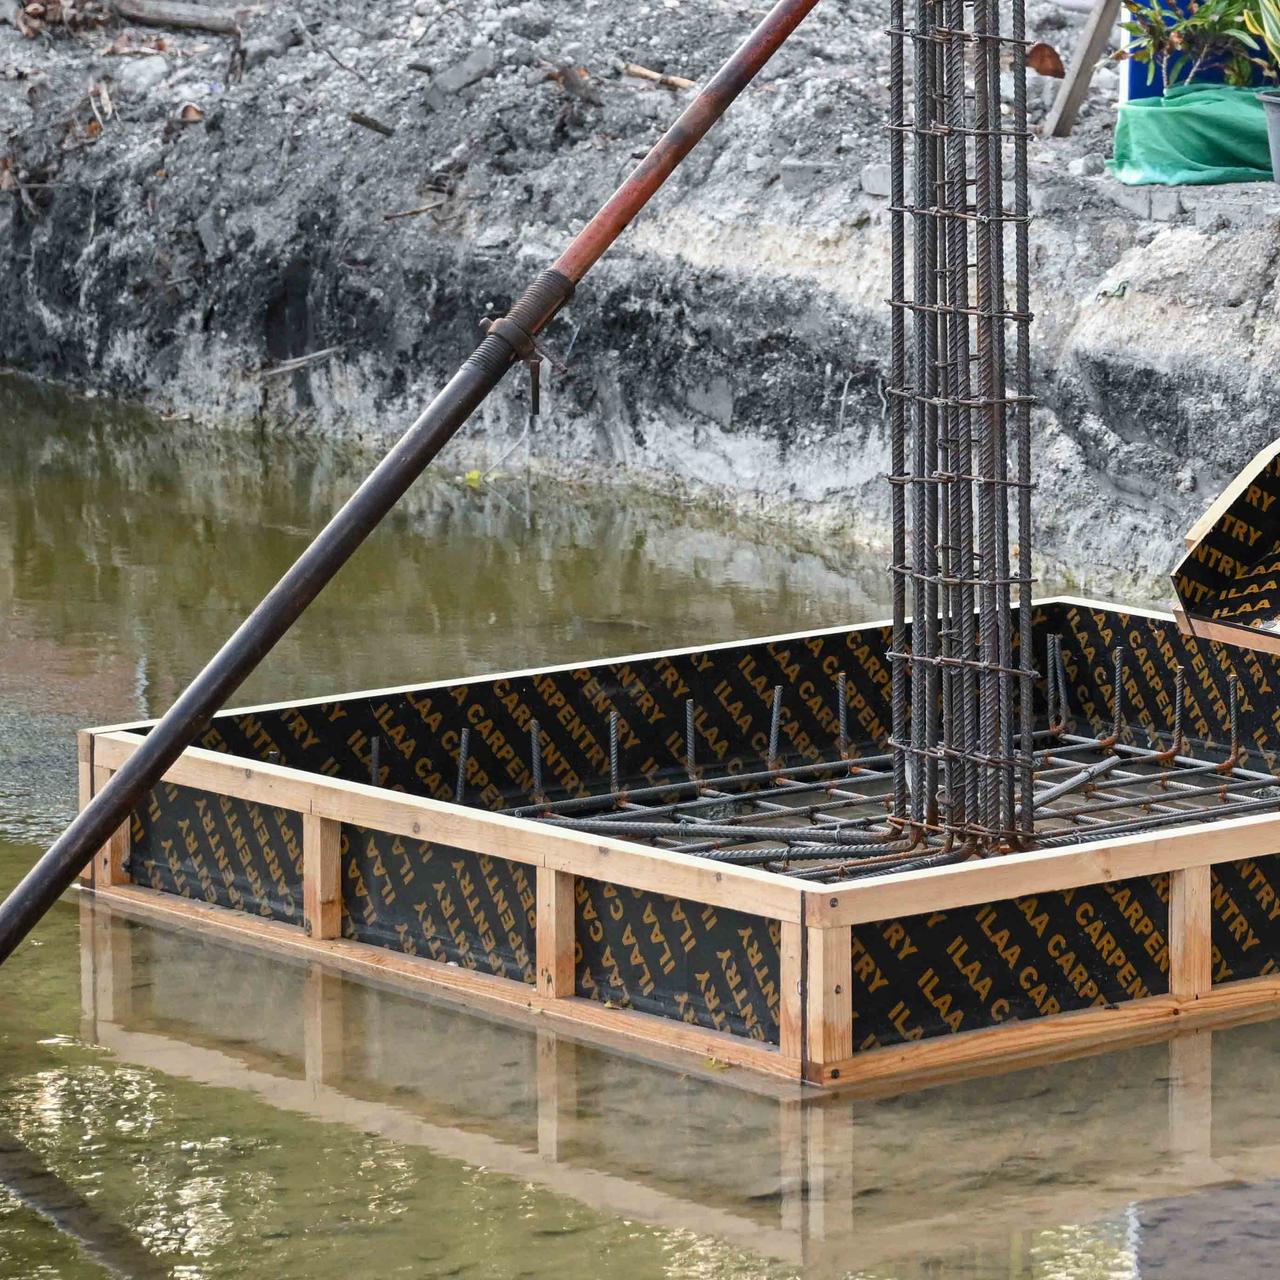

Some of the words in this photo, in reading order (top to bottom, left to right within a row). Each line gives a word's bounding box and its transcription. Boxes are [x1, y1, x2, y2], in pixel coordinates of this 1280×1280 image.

[1212, 599, 1272, 621] ILAA
[1219, 580, 1278, 601] ILAA
[374, 702, 416, 760] ILAA
[713, 680, 754, 736] ILAA
[348, 856, 377, 927] ILAA
[366, 836, 396, 905] ILAA
[622, 923, 656, 997] ILAA
[643, 902, 676, 976] ILAA
[946, 935, 993, 1004] ILAA
[975, 904, 1023, 970] ILAA
[917, 967, 964, 1033] ILAA
